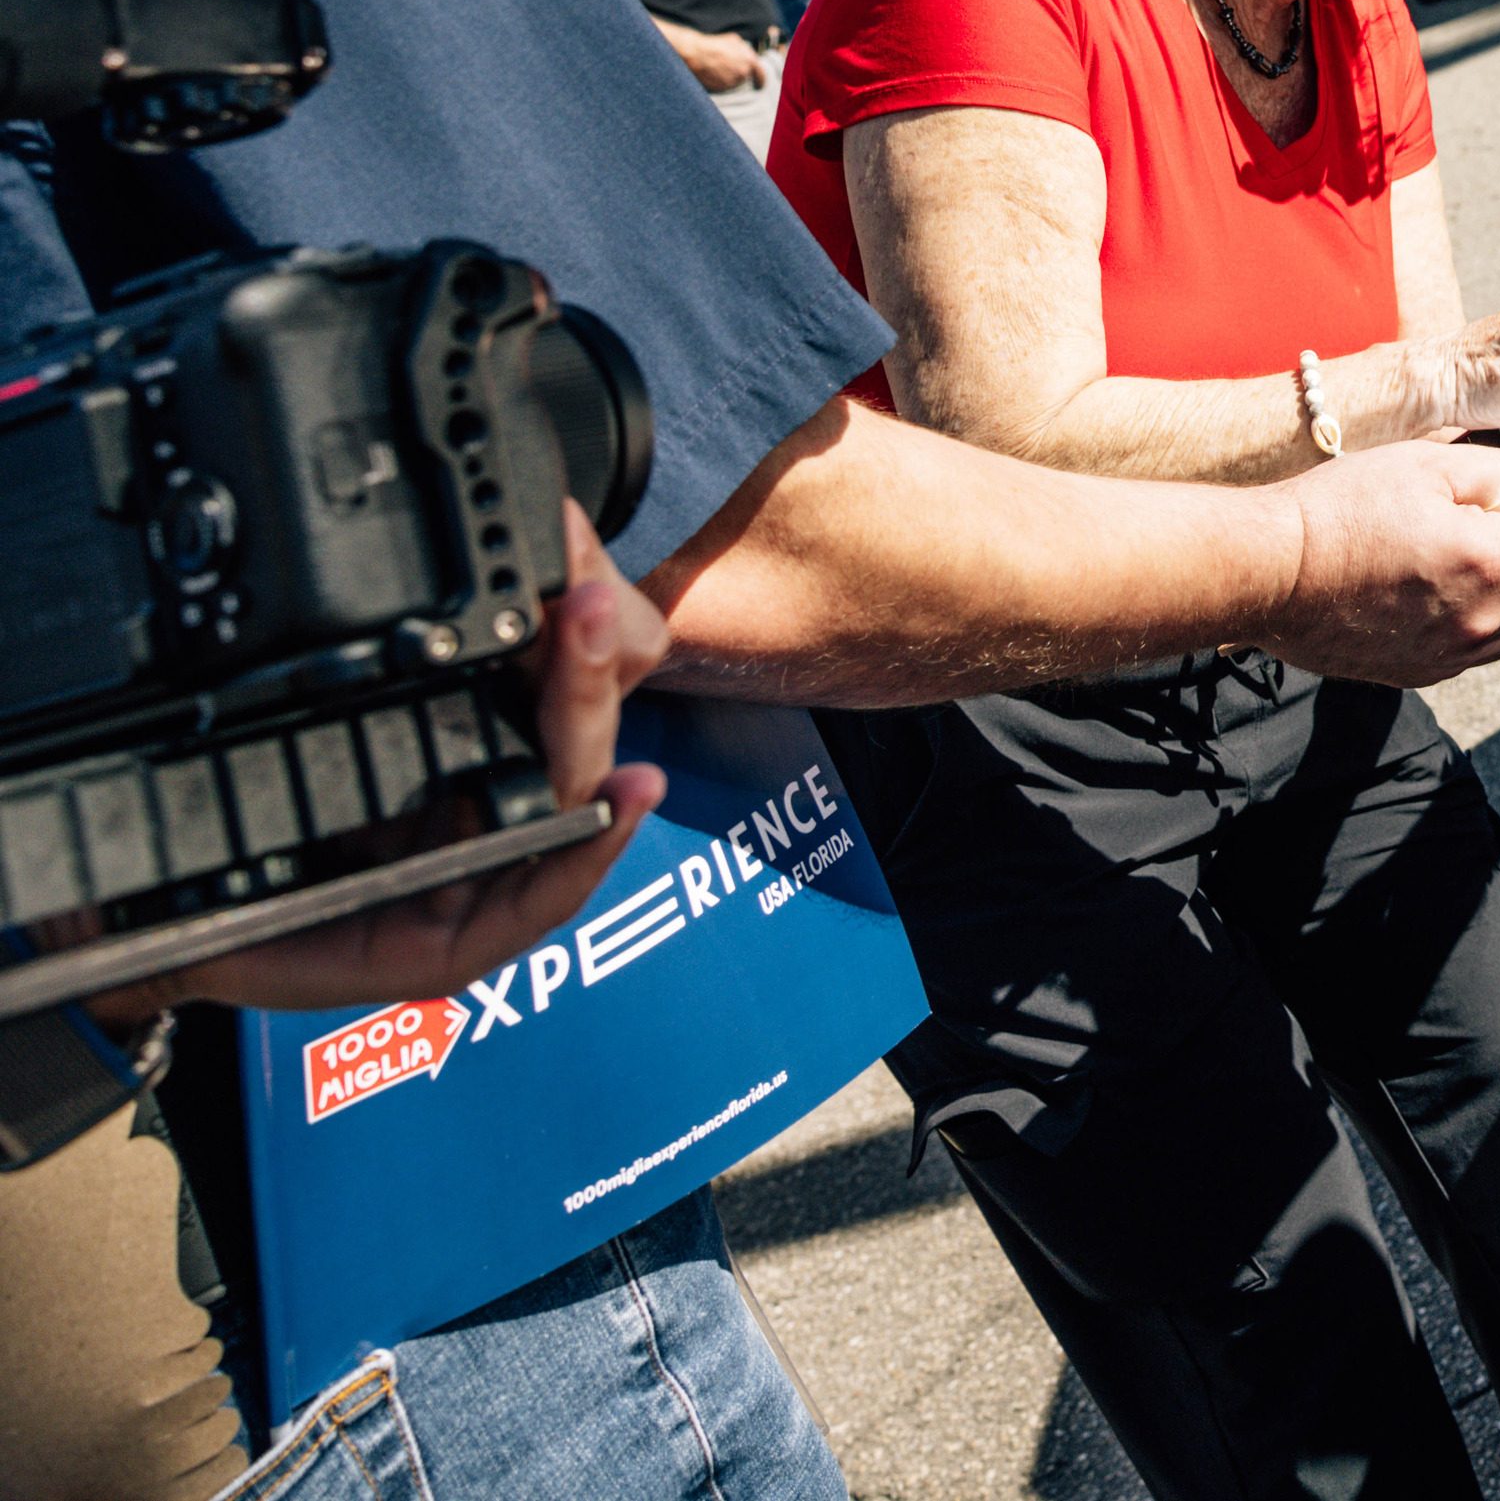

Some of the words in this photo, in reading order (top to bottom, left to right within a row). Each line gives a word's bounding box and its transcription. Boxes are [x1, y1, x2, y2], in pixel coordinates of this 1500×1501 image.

[758, 874, 796, 915] USA
[791, 828, 855, 891] FLORIDA
[317, 1037, 434, 1111] MIGLIA
[321, 1007, 424, 1070] 1000
[562, 1069, 789, 1214] 1000migliaexperienceflorida.us
